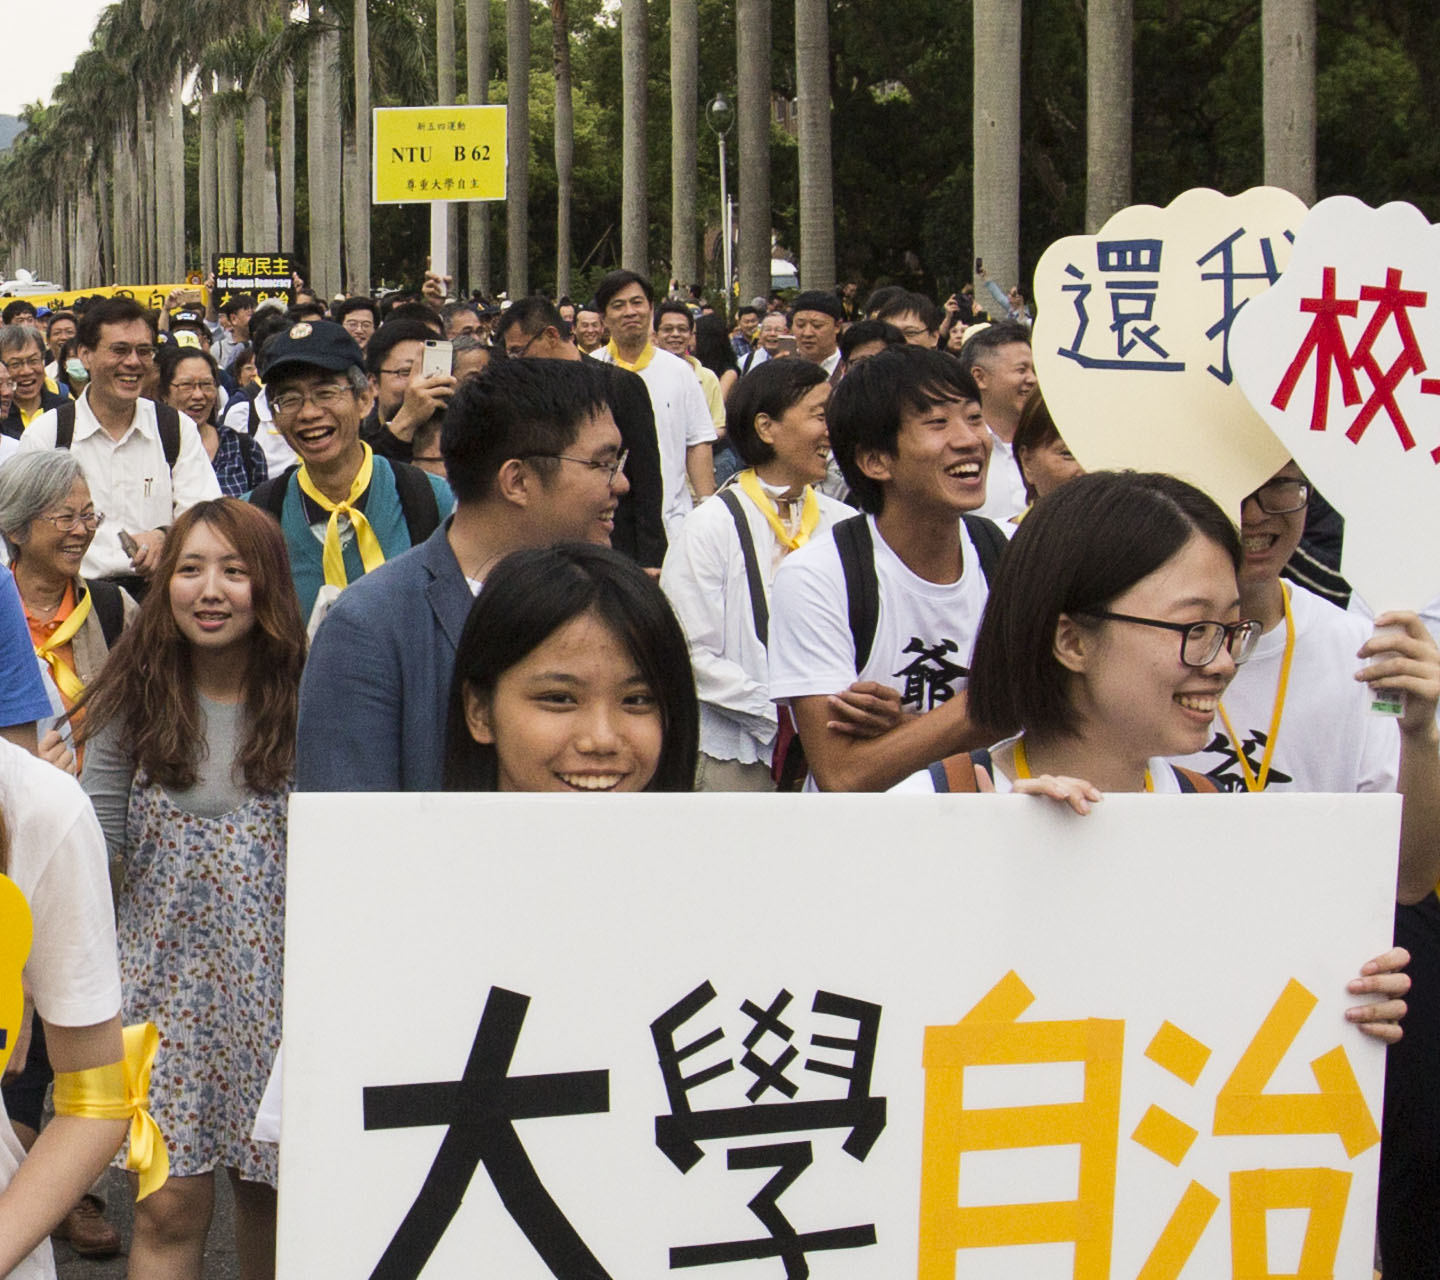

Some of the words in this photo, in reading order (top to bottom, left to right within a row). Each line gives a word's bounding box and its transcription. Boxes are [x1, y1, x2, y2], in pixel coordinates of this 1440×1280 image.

[391, 145, 432, 163] NTU
[454, 145, 466, 162] B
[472, 145, 491, 161] 62
[407, 178, 480, 191] 尊重大學自主
[217, 257, 289, 276] 捍衛民主
